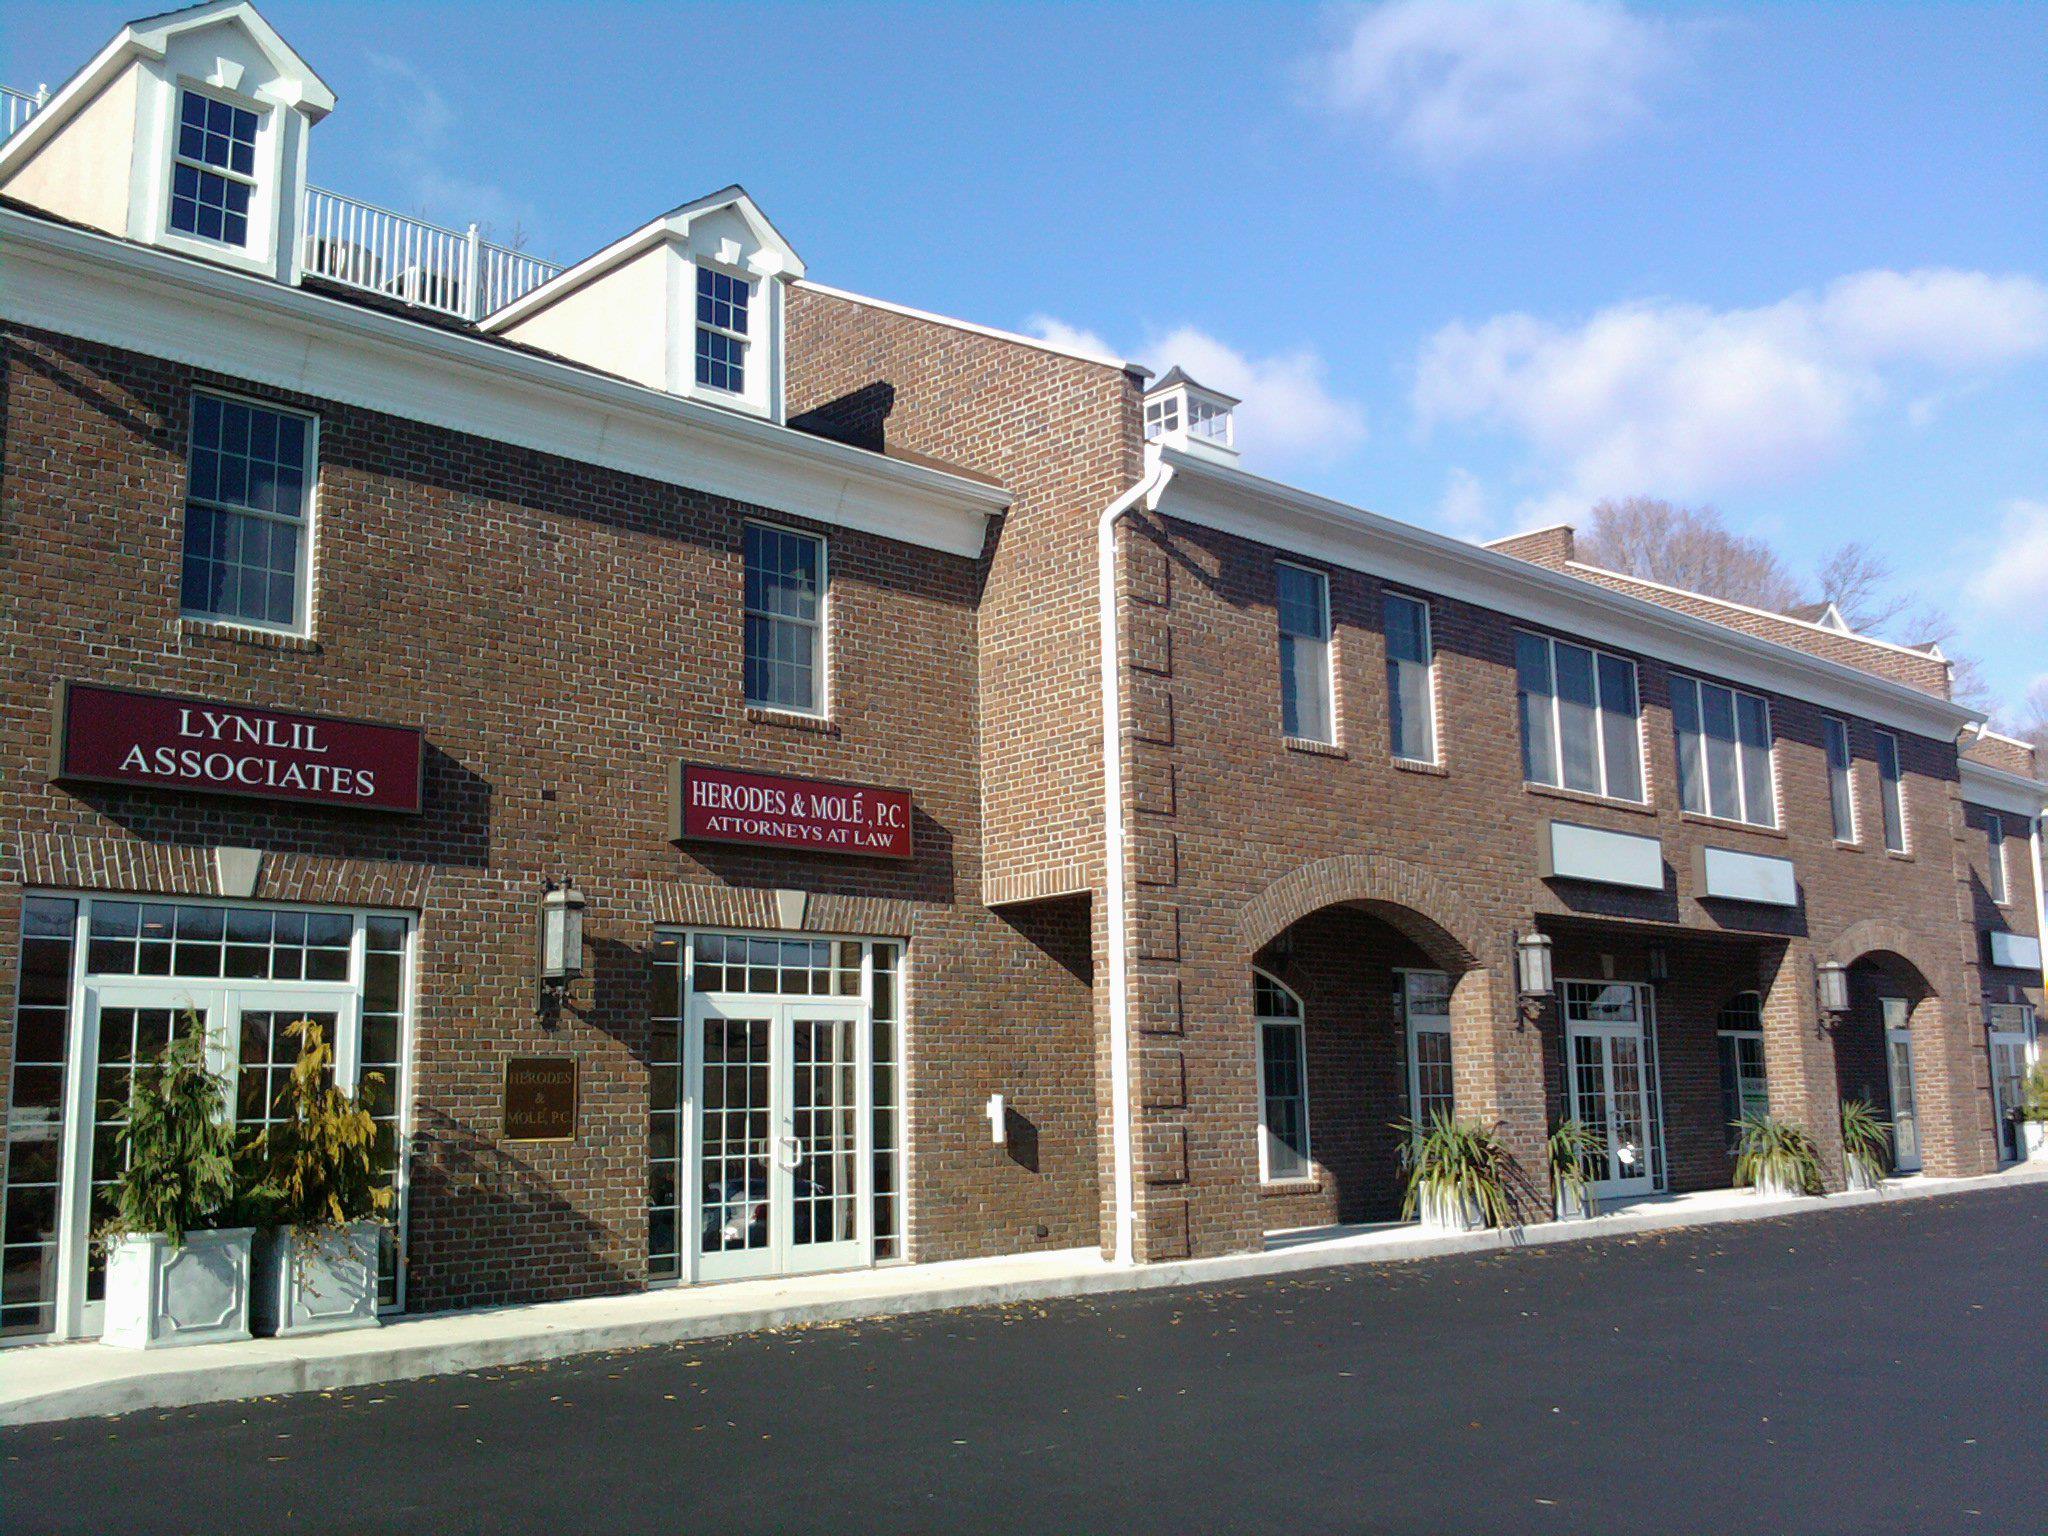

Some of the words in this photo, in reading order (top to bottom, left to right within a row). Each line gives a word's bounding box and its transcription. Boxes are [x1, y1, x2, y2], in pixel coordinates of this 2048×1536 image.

[179, 708, 328, 752] LYNLIL
[118, 743, 376, 797] ASSOCIATES
[692, 780, 786, 816] HERODES
[790, 793, 806, 818] &
[706, 816, 822, 842] ATTORNEYS
[826, 828, 850, 844] AT
[854, 830, 894, 848] LAW
[509, 1071, 572, 1085] HERODES
